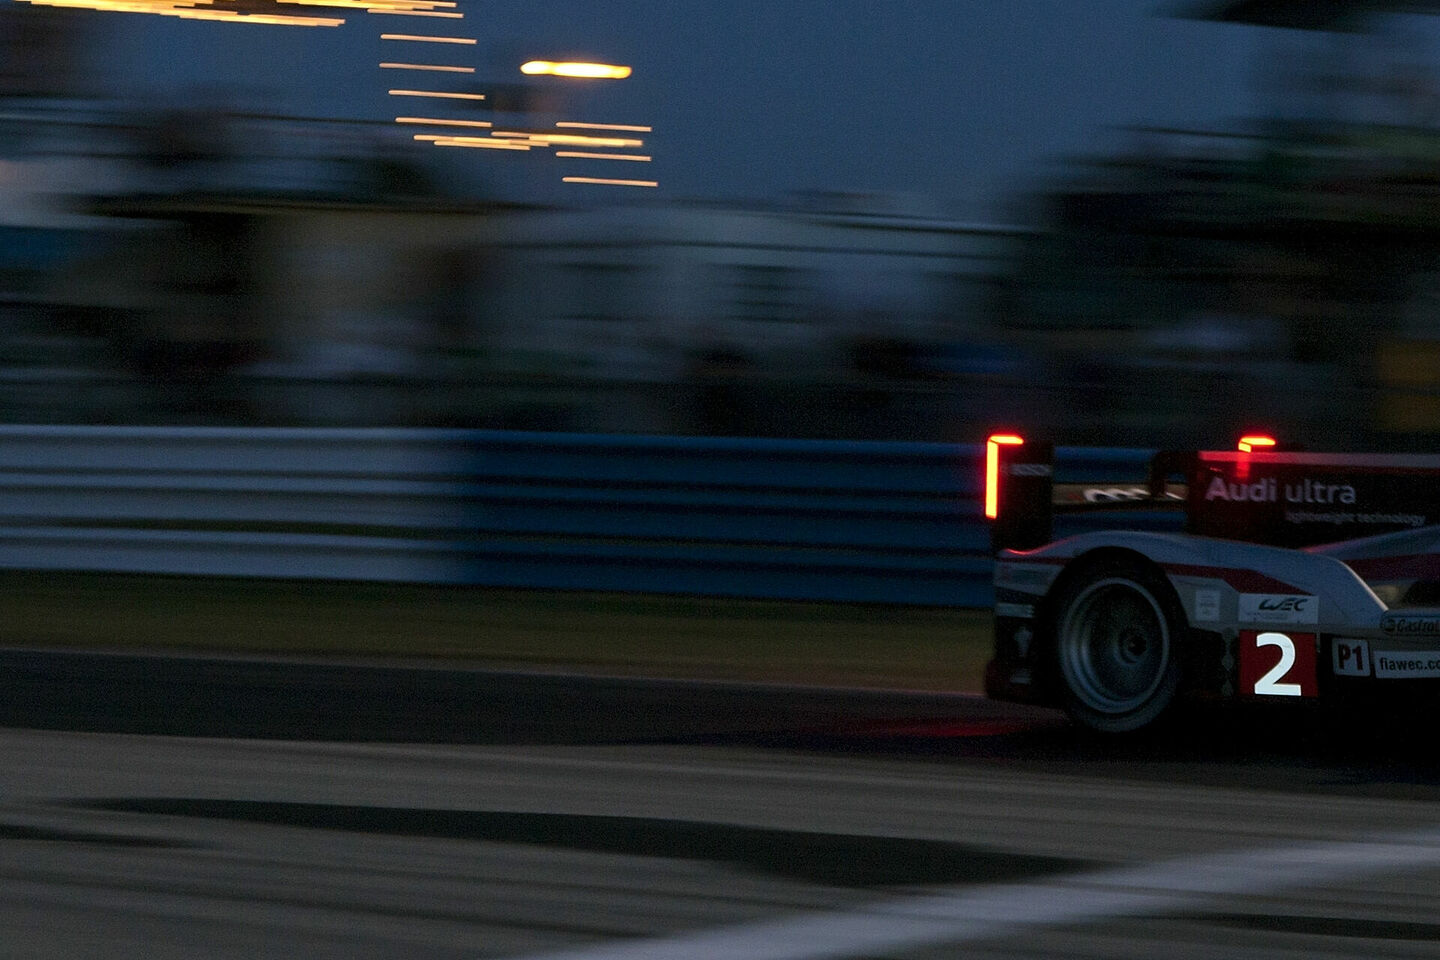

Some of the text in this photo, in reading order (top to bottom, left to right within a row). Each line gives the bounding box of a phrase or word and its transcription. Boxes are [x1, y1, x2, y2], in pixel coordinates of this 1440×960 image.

[1205, 475, 1356, 504] Audi ultra
[1258, 597, 1308, 612] WEC
[1397, 618, 1439, 632] Castrol
[1254, 631, 1303, 697] 2
[1338, 644, 1364, 670] P1
